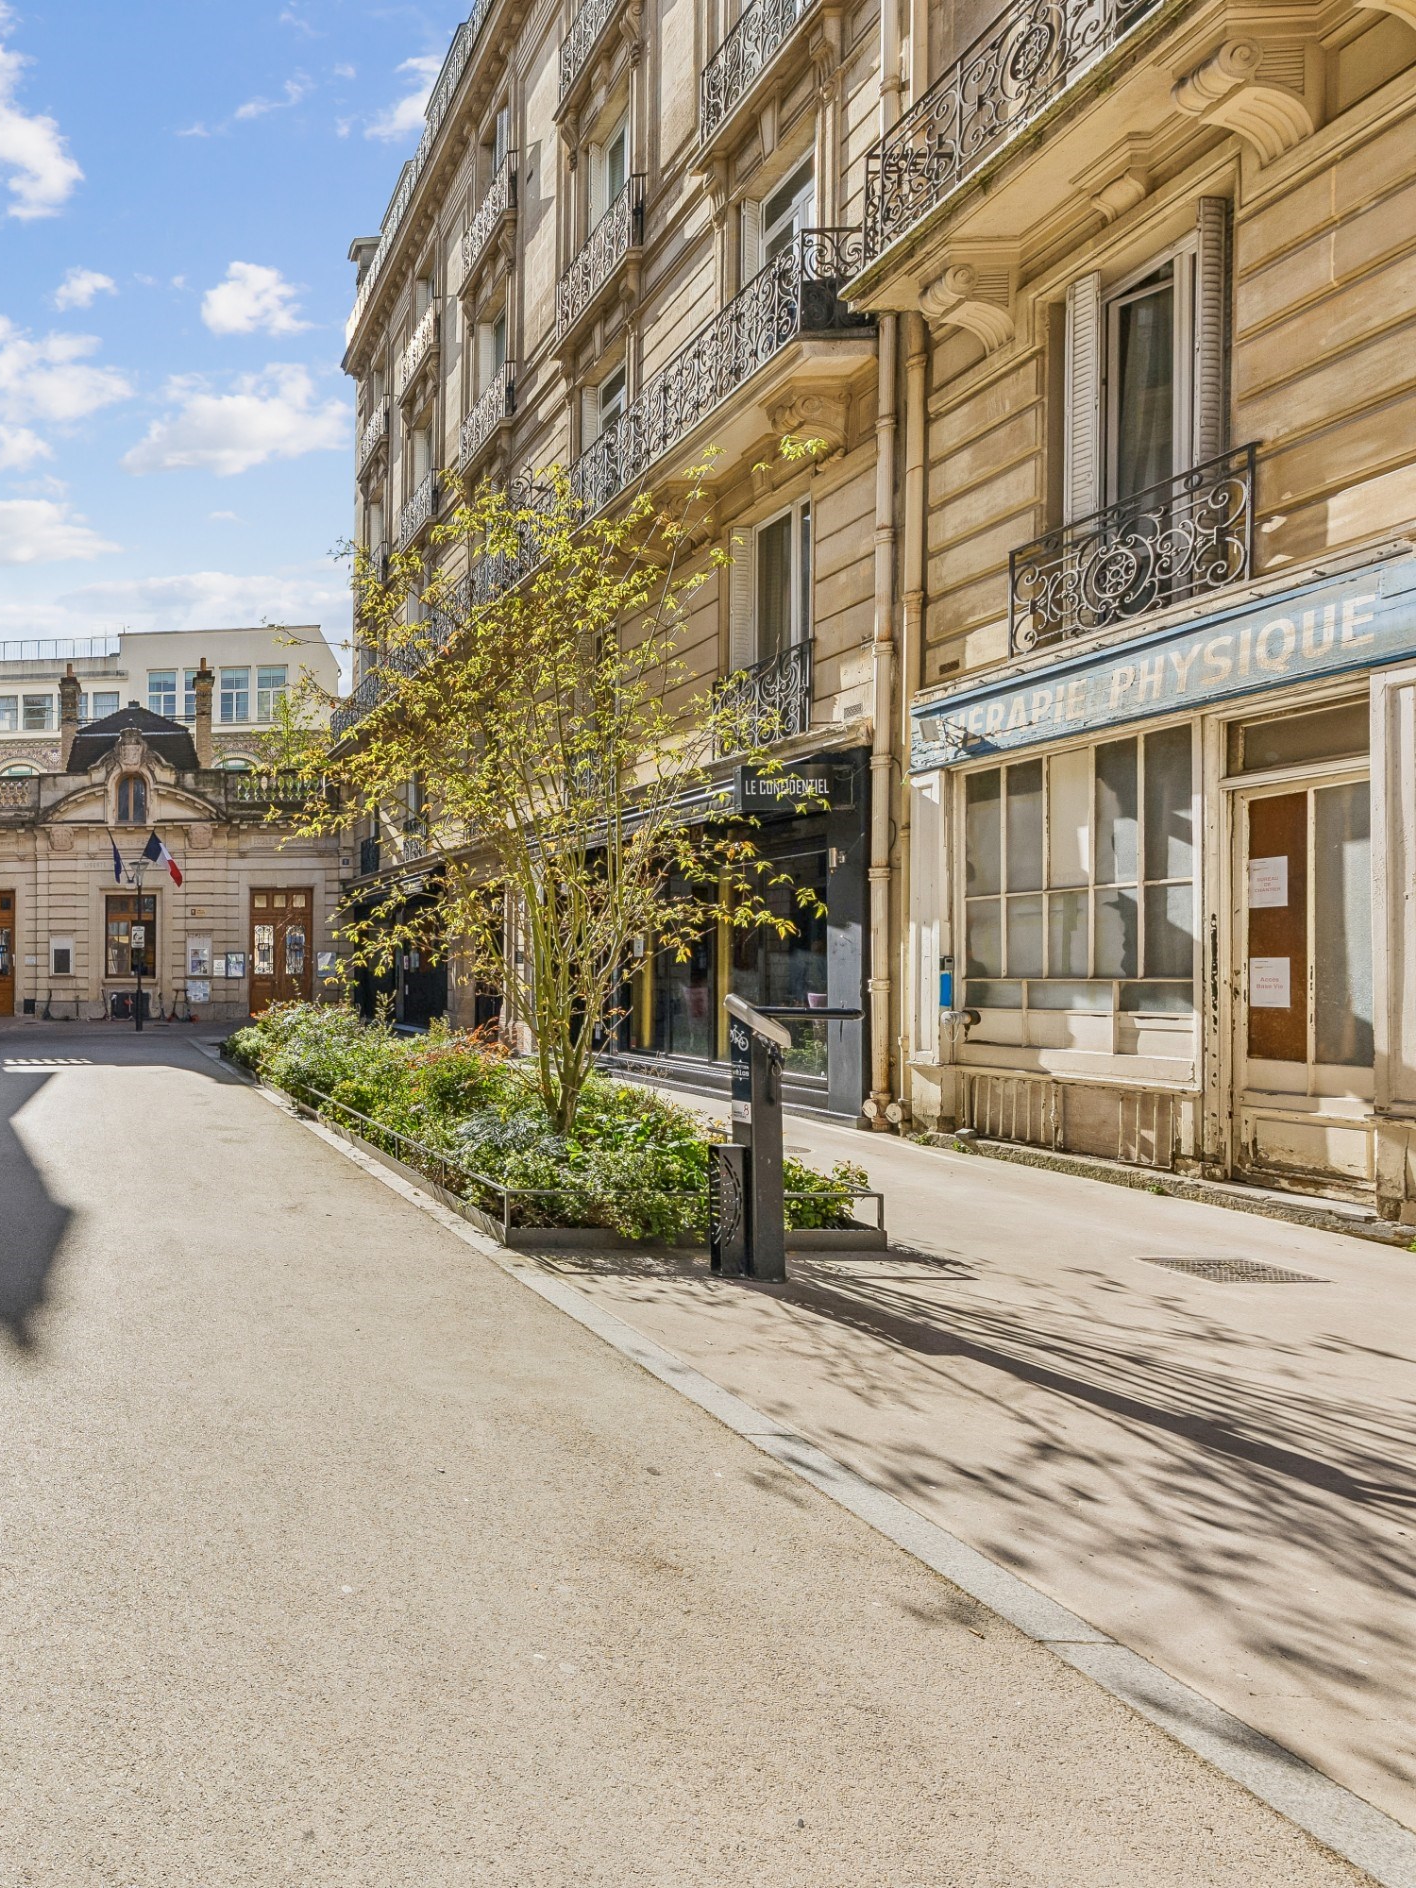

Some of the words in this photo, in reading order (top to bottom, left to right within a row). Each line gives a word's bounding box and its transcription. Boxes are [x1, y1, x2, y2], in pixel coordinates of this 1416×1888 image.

[940, 679, 1087, 738] HÉRAPIE
[1109, 594, 1376, 710] PHYSIQUE
[745, 780, 757, 795] LE
